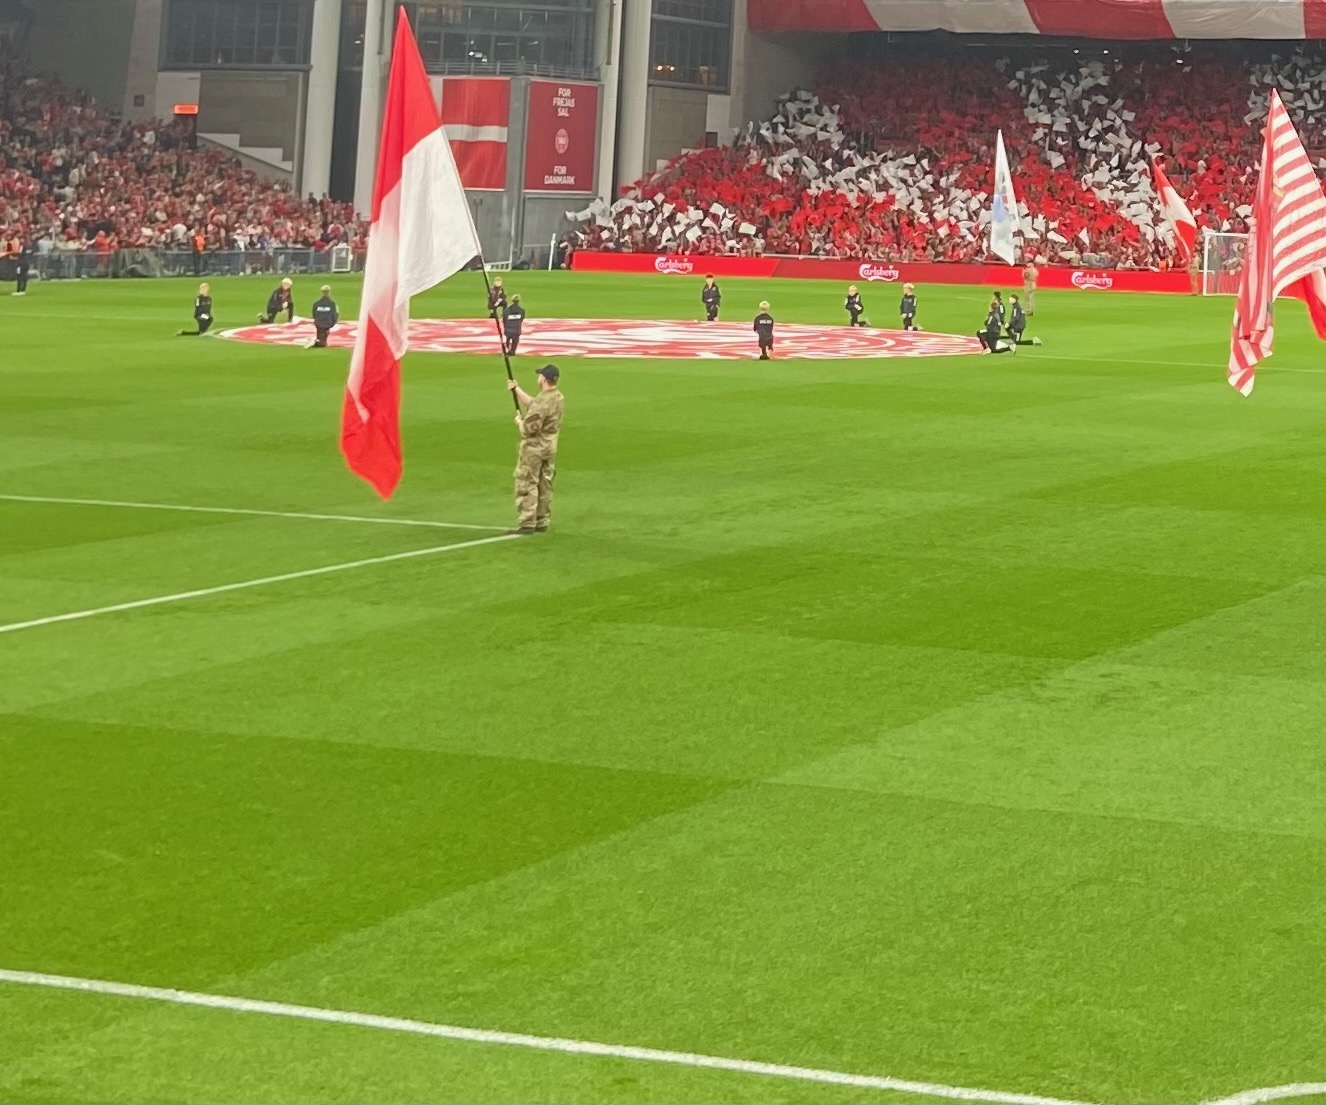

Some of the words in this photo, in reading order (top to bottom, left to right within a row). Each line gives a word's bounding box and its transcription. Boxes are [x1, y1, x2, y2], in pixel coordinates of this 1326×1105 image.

[558, 87, 571, 97] FOR
[553, 165, 567, 175] FOR
[544, 175, 575, 185] DANMARK
[654, 257, 693, 274] Carlsberg
[859, 264, 899, 281] Carlsberg
[1071, 271, 1113, 289] Carlsberg
